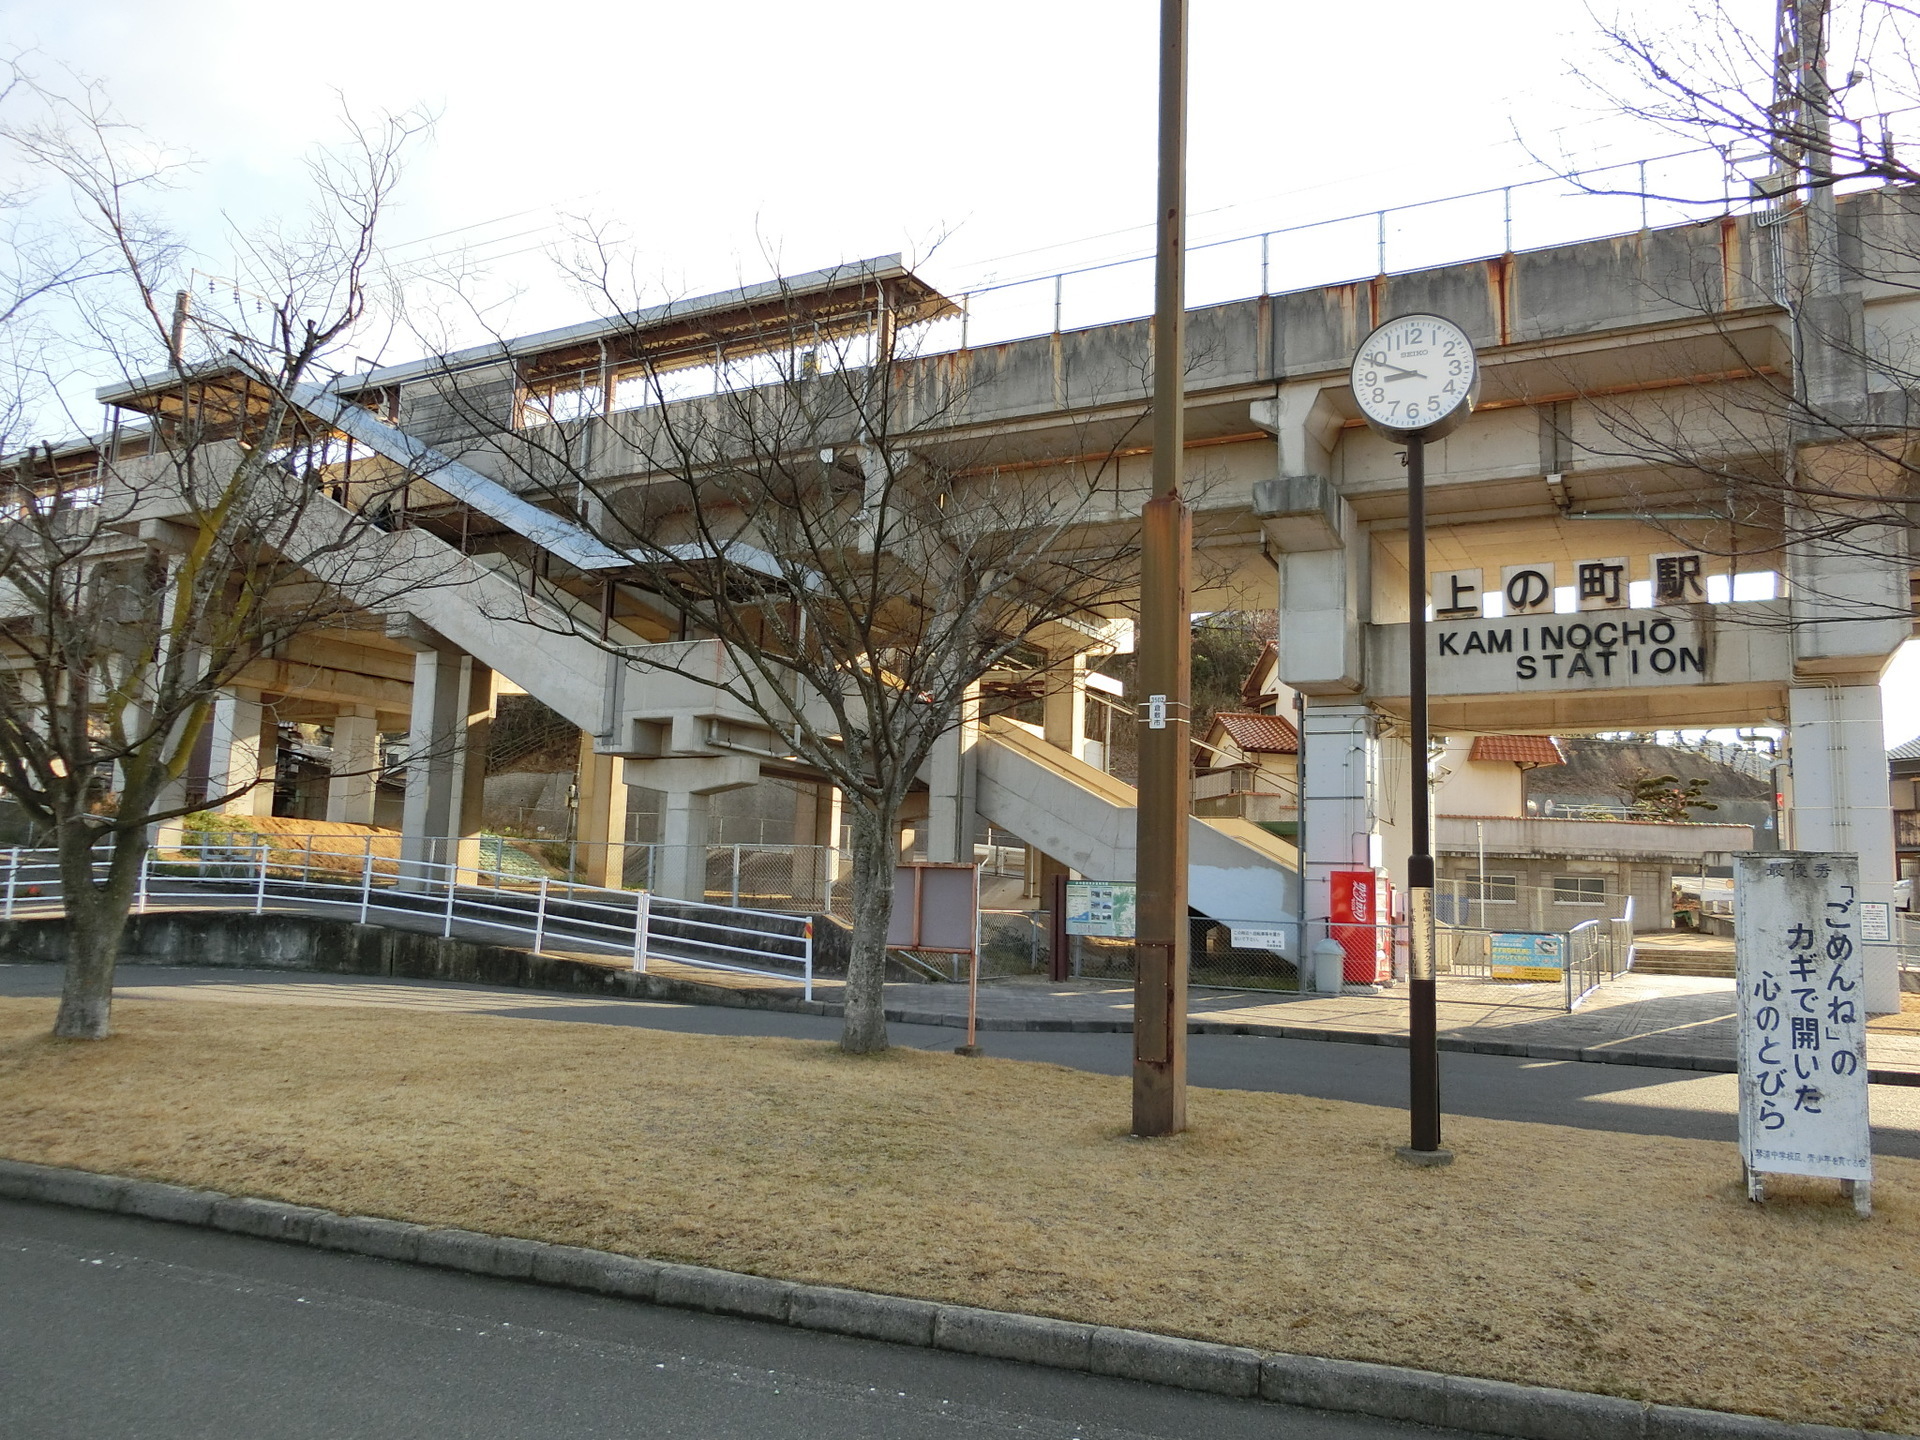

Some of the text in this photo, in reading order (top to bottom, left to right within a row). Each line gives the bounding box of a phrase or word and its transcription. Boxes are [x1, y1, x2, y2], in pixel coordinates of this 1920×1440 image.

[1387, 335, 1399, 351] 11
[1405, 328, 1423, 345] 12
[1432, 330, 1436, 346] 1
[1400, 349, 1429, 358] SEIKO
[1443, 341, 1456, 357] 2
[1369, 351, 1387, 368] 10
[1448, 360, 1462, 376] 3
[1364, 371, 1377, 387] 9
[1372, 387, 1385, 403] 8
[1442, 380, 1456, 395] 4
[1388, 401, 1400, 416] 7
[1406, 403, 1419, 419] 6
[1427, 395, 1440, 412] 5
[1436, 555, 1703, 613] 上の町駅
[1516, 647, 1704, 680] STATION
[1766, 862, 1833, 879] 最優秀
[1825, 885, 1857, 1076] 「ごめんね」の
[1787, 923, 1822, 1114] カギで開いた
[1754, 970, 1787, 1130] 心のとびら
